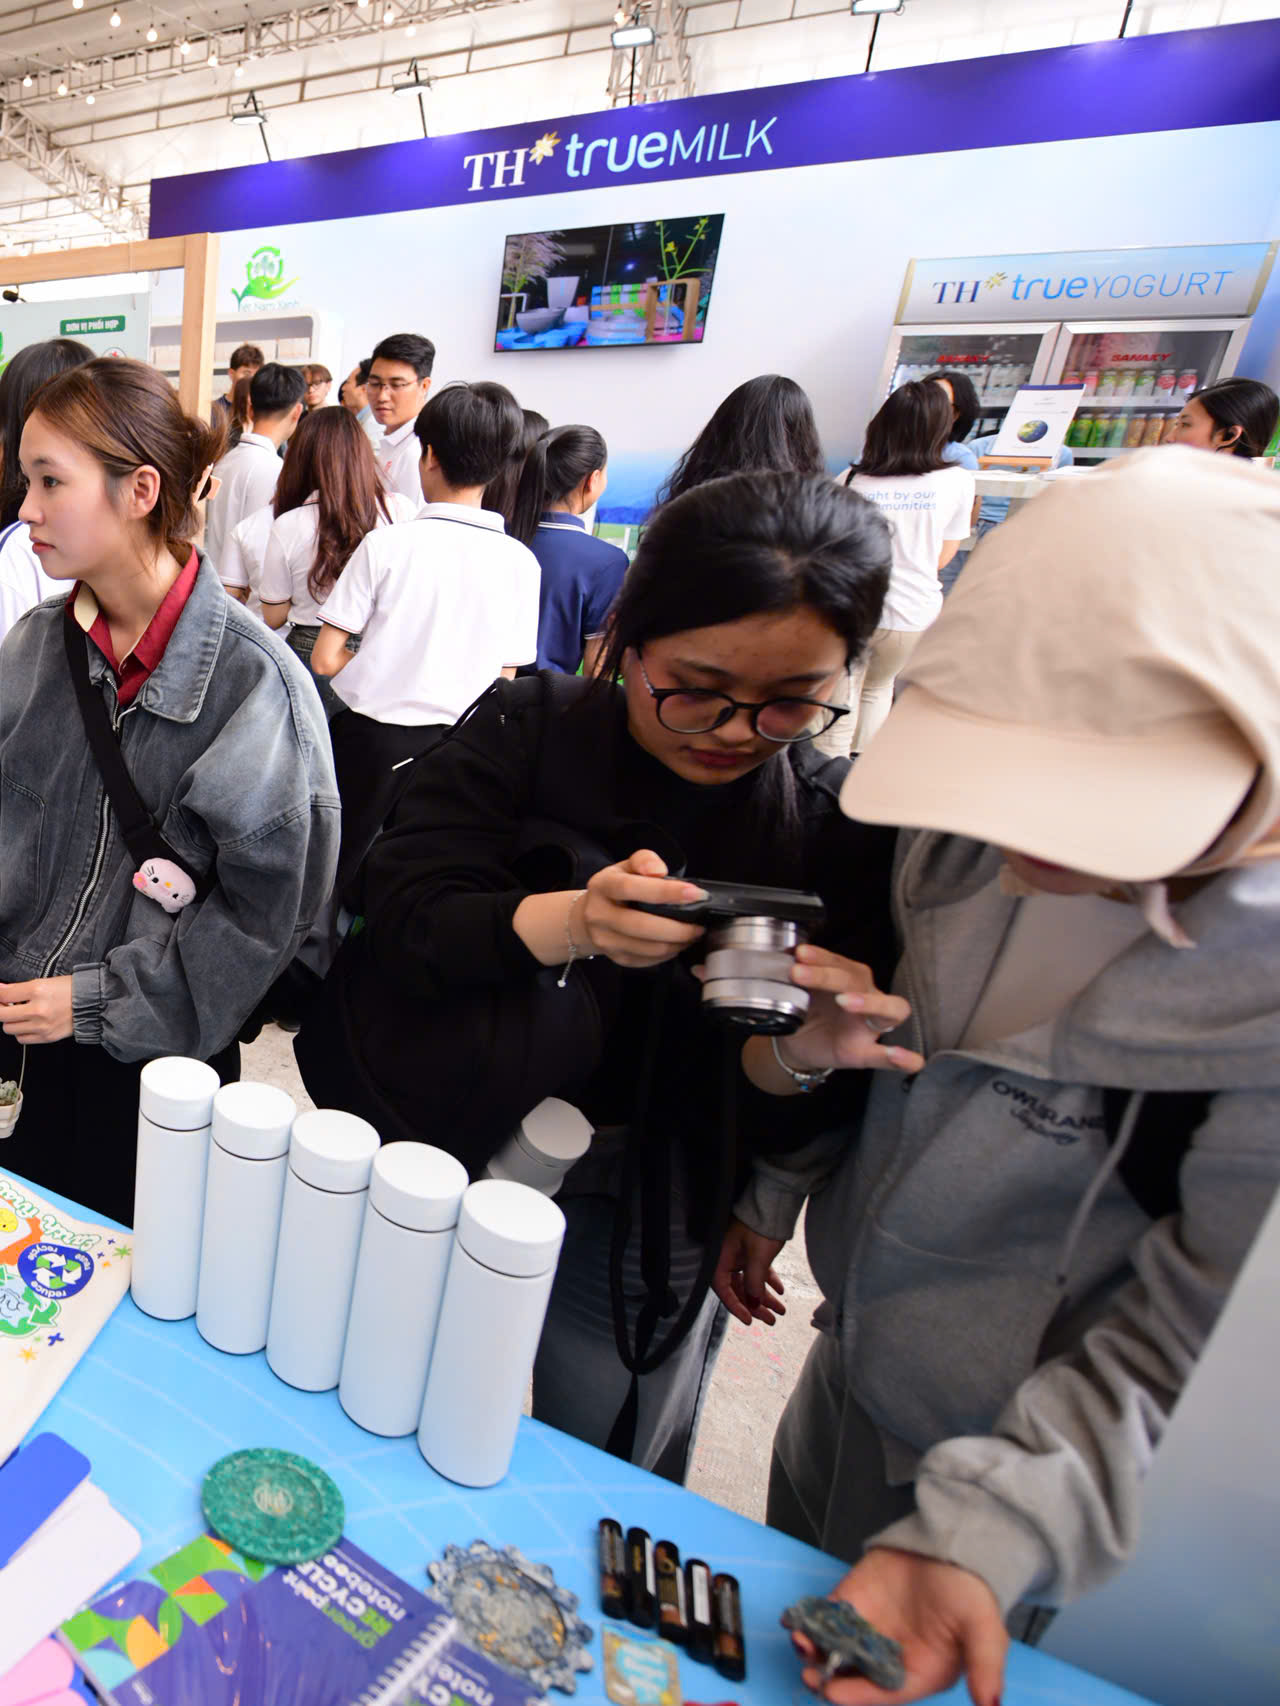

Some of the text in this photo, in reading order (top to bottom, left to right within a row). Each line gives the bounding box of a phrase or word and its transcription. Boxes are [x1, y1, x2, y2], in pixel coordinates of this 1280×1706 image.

[464, 116, 778, 192] TH trueMILK
[932, 269, 1235, 304] TH trueYOGURT
[878, 501, 937, 511] munities
[894, 489, 910, 501] by
[30, 1280, 67, 1298] reduce
[322, 1554, 407, 1623] noteboo
